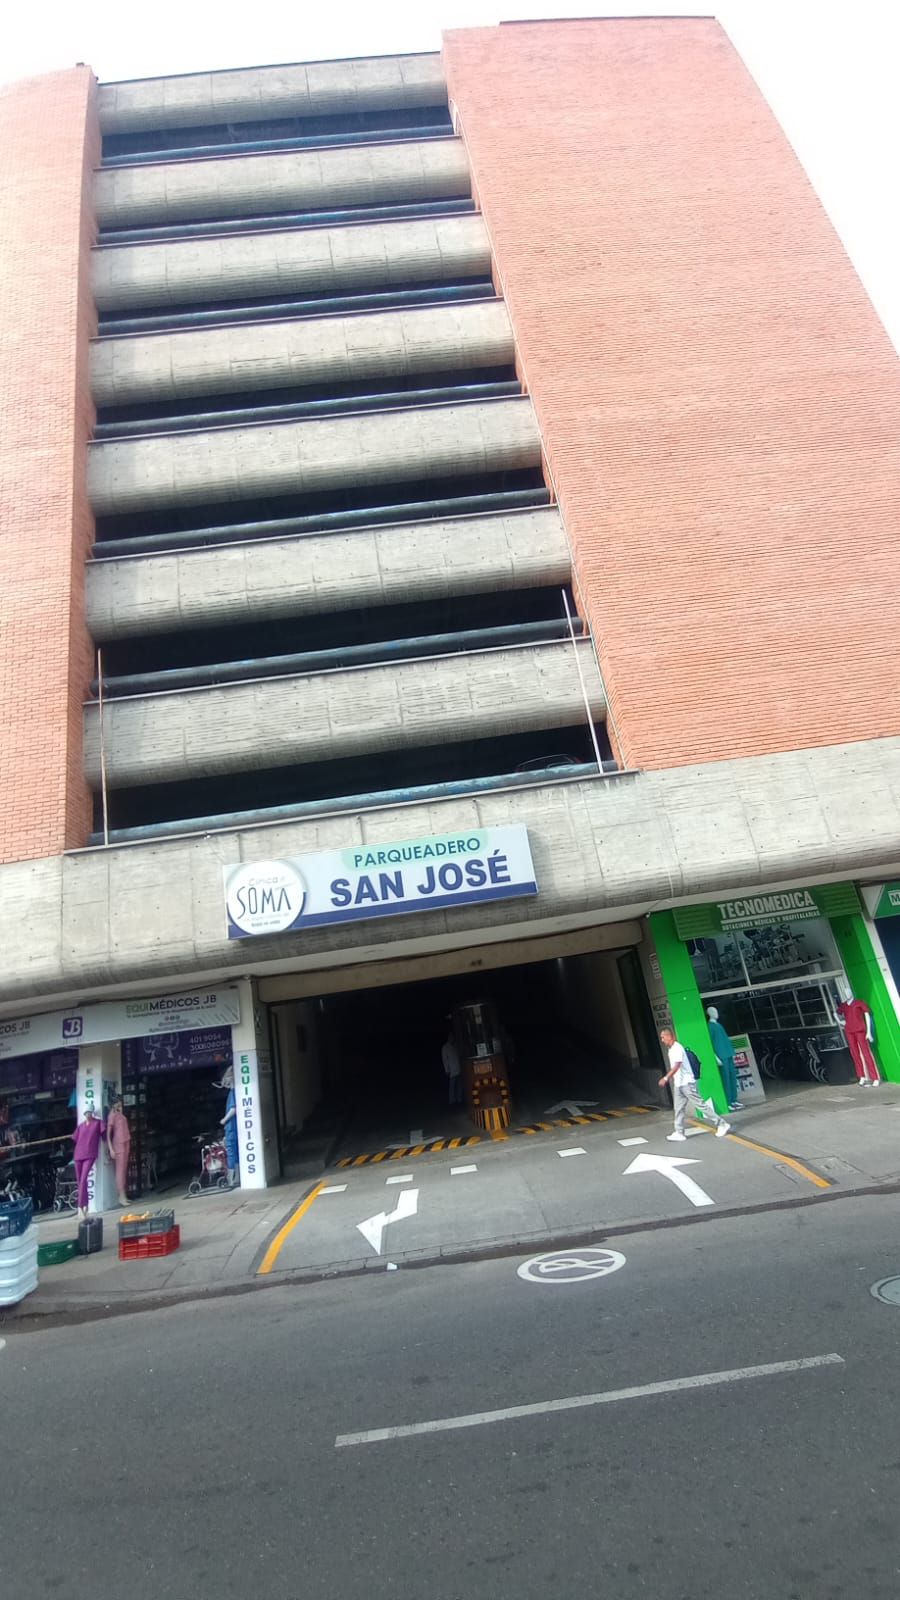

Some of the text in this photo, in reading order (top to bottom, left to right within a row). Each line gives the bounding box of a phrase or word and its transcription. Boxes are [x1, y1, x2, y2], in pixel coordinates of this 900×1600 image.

[354, 837, 481, 868] PARQUEADERO
[330, 849, 511, 907] SAN JOSÉ
[236, 886, 292, 919] SOMA
[717, 891, 814, 919] TECNOMEDICA
[126, 995, 200, 1015] EQUIMÉDICOS
[203, 994, 217, 1005] JB
